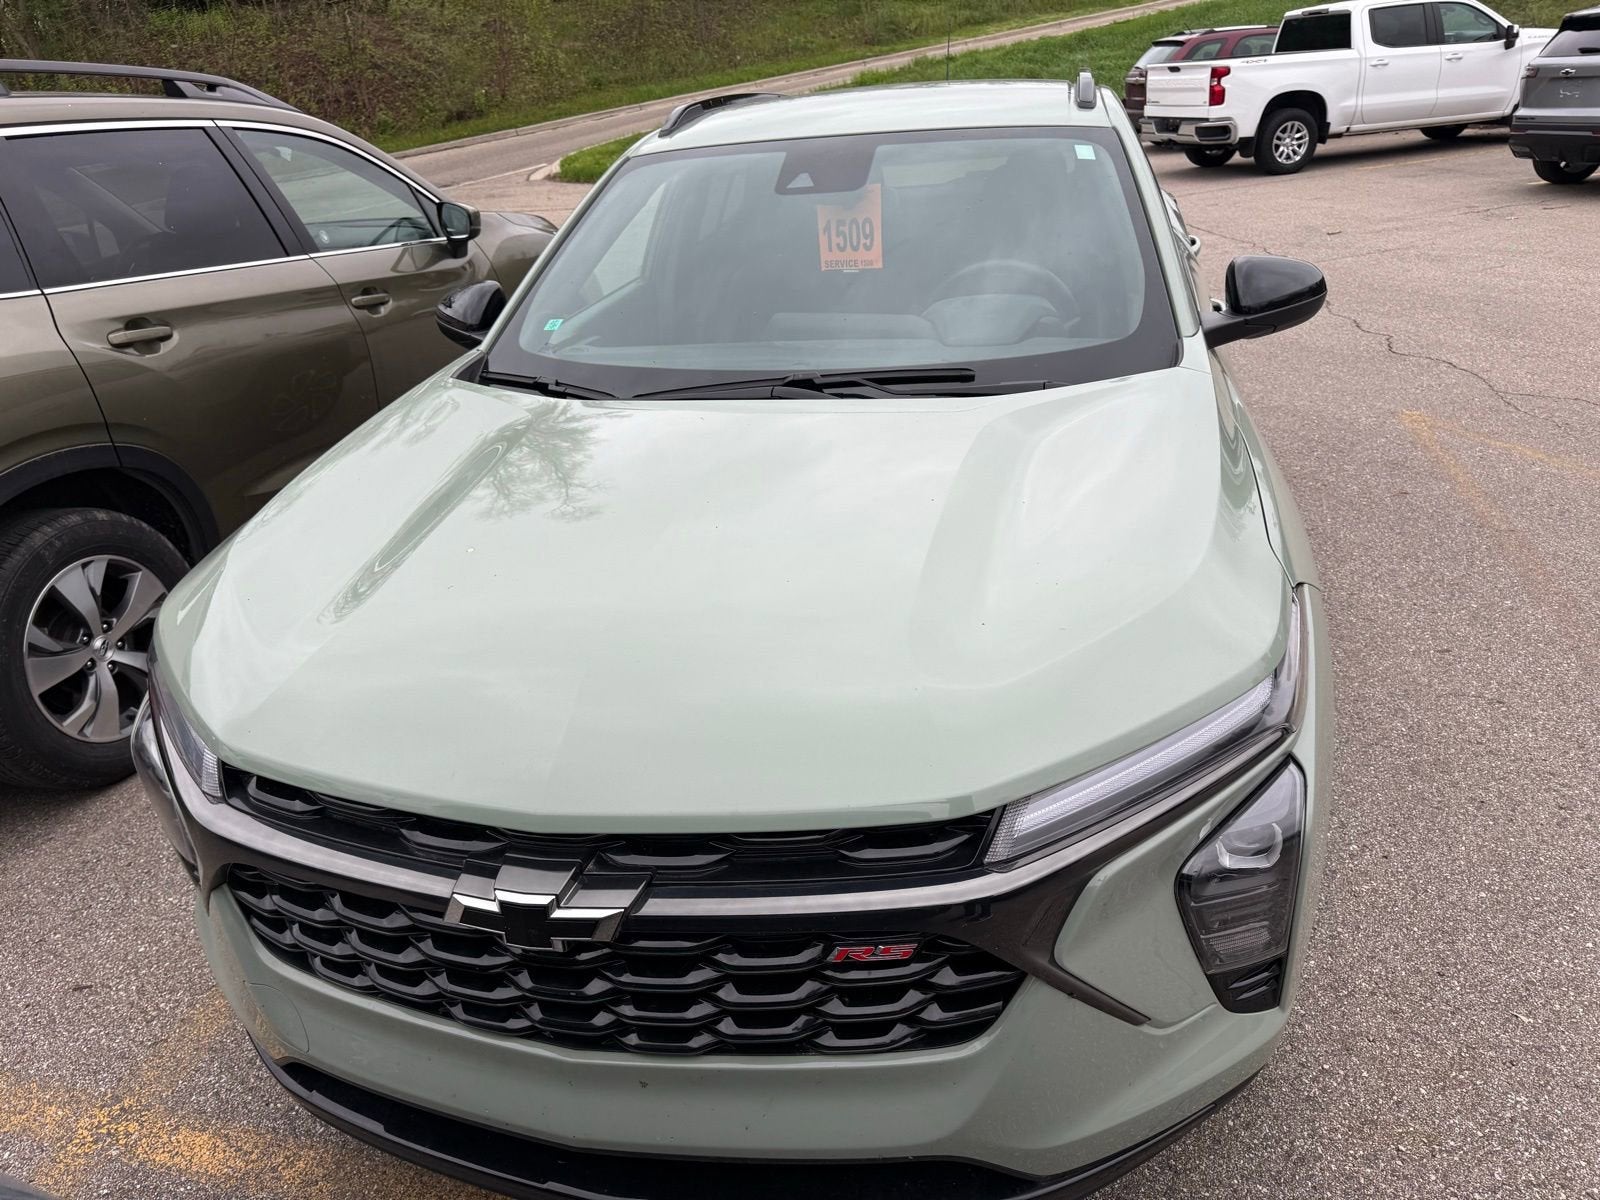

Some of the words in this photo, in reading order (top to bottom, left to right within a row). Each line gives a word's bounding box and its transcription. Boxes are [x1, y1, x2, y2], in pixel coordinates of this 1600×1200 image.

[823, 216, 875, 253] 1509
[824, 259, 859, 269] SERVICE
[826, 943, 918, 962] RS
